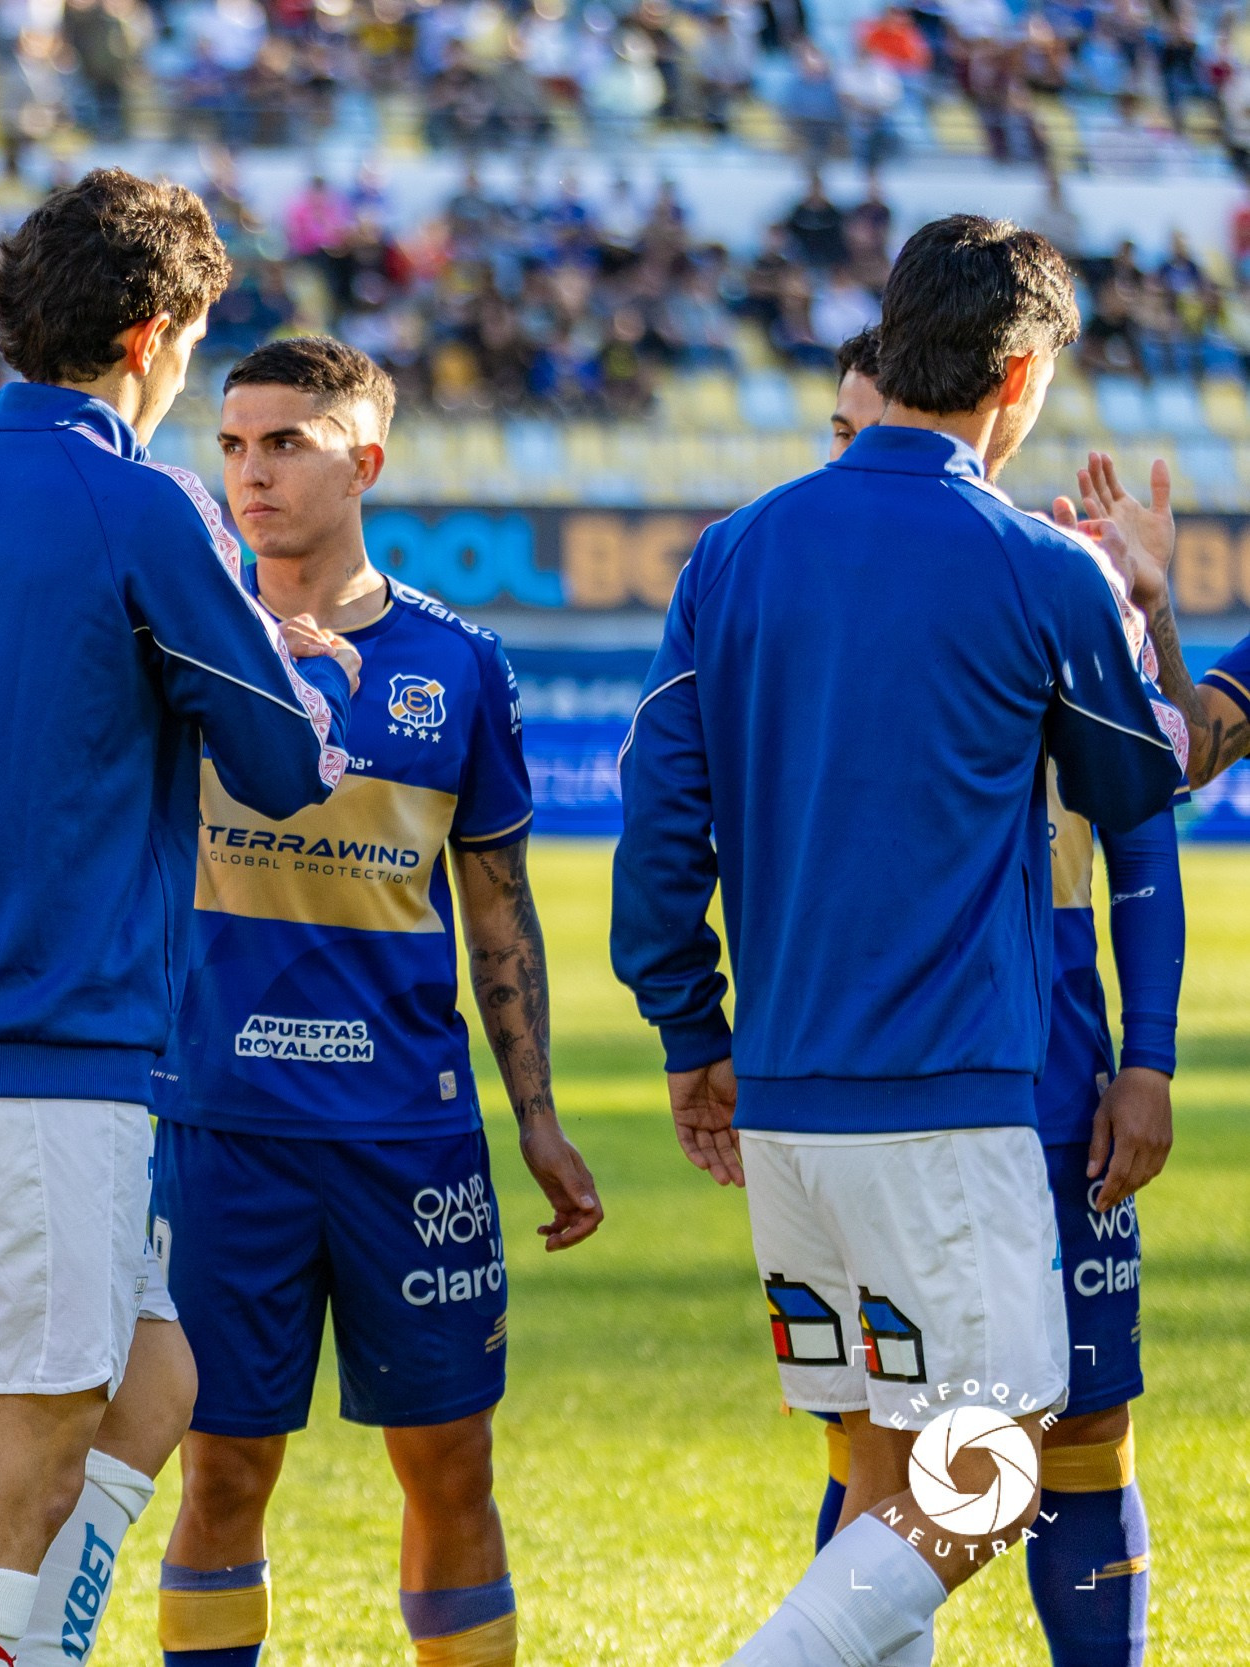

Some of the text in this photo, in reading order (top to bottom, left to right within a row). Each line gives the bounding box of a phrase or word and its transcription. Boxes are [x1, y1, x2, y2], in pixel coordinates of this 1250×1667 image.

[397, 585, 480, 635] Claro
[206, 826, 420, 868] TERRAWIND
[210, 851, 413, 885] GLOBAL PROTECTION
[238, 1038, 370, 1059] ROYAL.COM
[247, 1019, 365, 1040] APUESTAS
[402, 1260, 502, 1306] Claro
[62, 1522, 115, 1662] 1XBET
